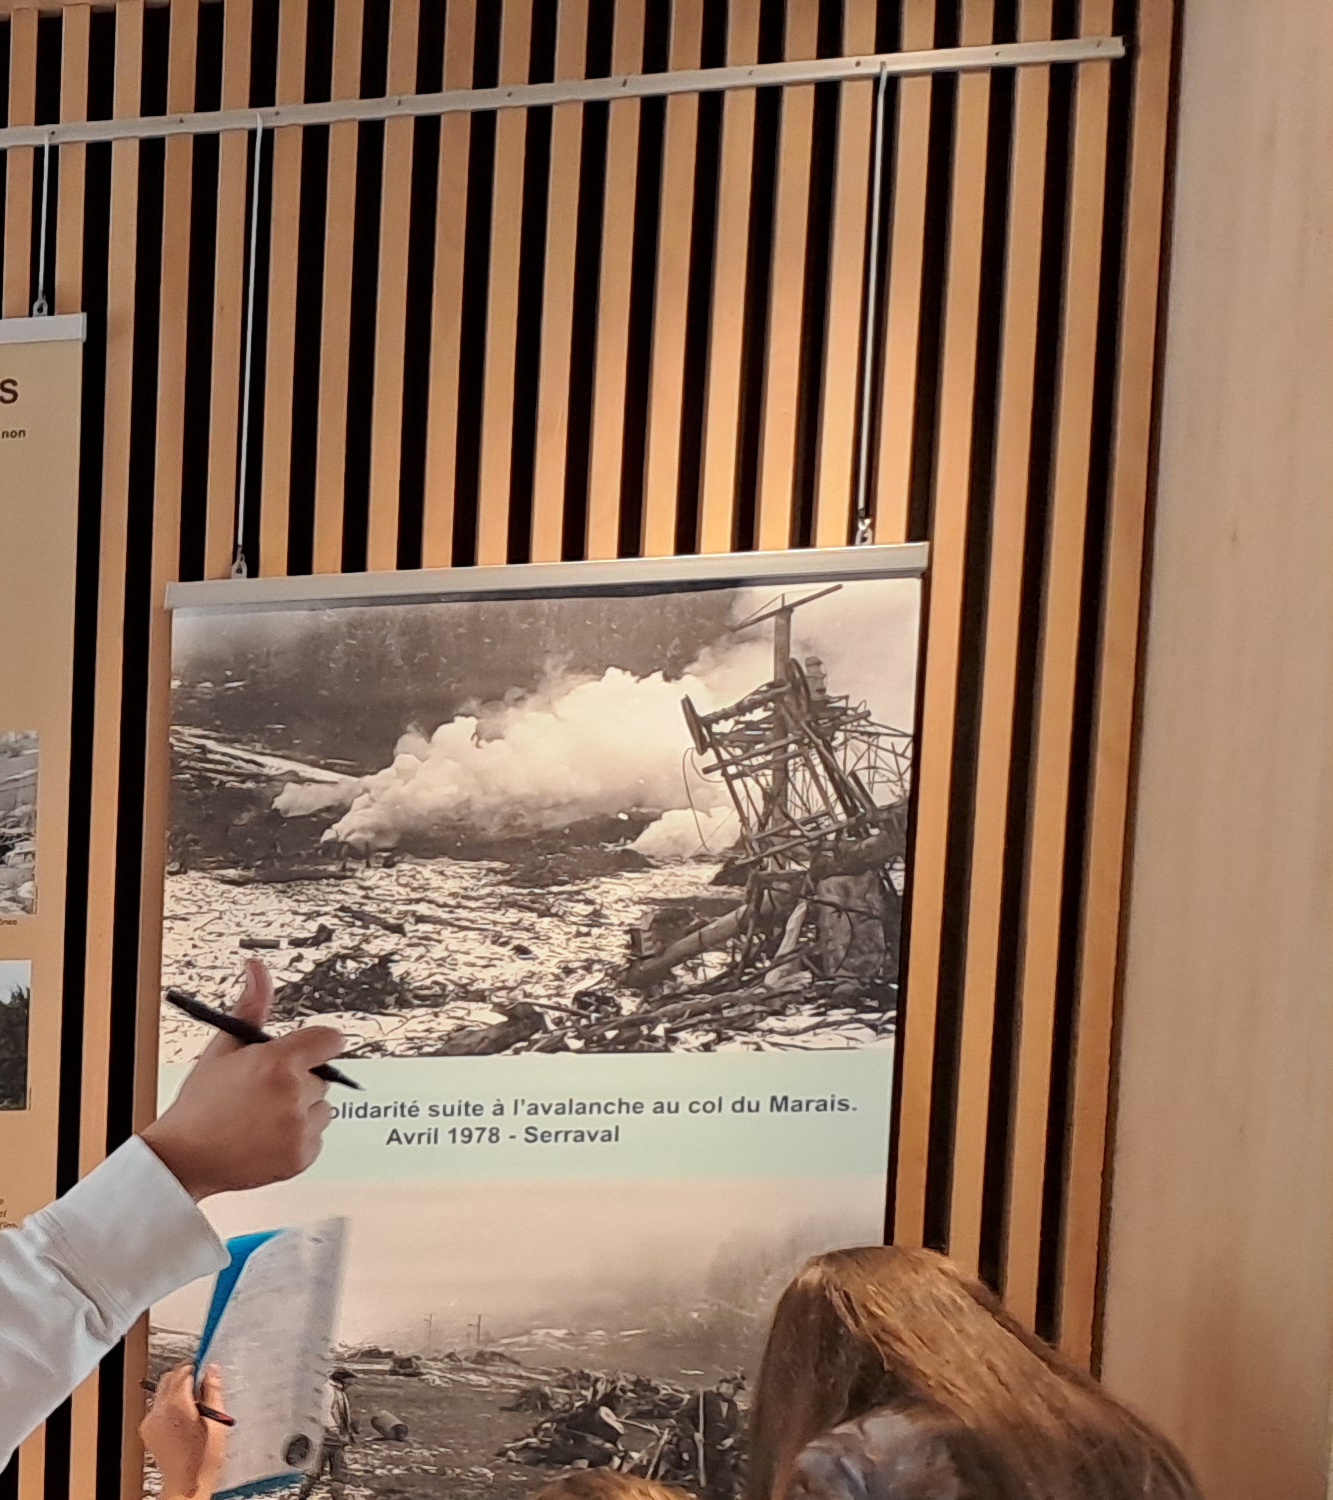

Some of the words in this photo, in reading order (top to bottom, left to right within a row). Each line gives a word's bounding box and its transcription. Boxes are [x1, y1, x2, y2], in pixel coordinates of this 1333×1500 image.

[329, 1100, 419, 1119] olidarité
[428, 1100, 483, 1117] suite
[491, 1098, 504, 1116] à
[513, 1098, 644, 1115] l'avalanche
[652, 1100, 679, 1114] au
[688, 1096, 722, 1113] col
[731, 1096, 760, 1113] du
[769, 1094, 857, 1112] Marais.
[385, 1127, 438, 1144] Avril
[447, 1126, 499, 1143] 1978
[523, 1125, 619, 1143] Serraval
